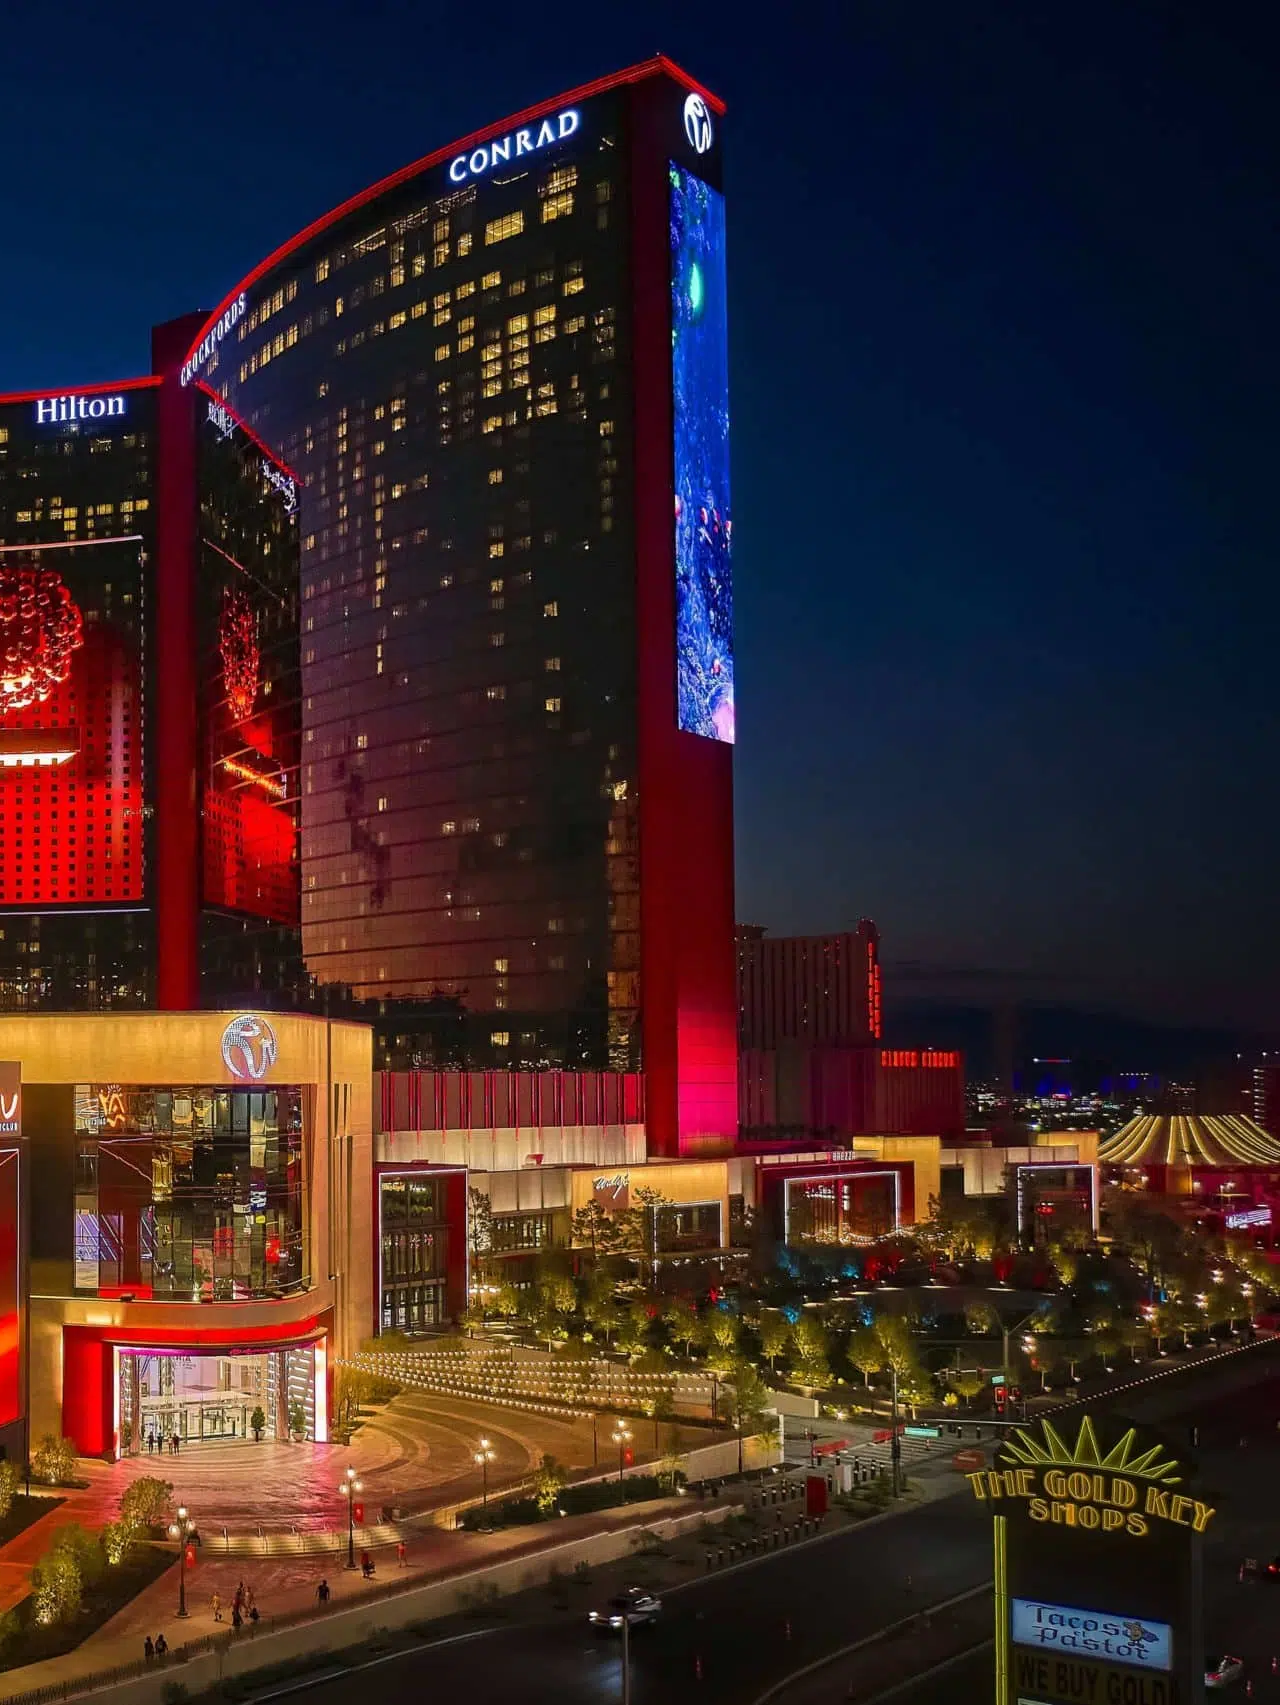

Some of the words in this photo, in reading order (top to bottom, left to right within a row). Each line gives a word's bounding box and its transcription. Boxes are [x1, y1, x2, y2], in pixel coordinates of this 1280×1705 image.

[449, 110, 581, 182] CONRAD
[180, 291, 247, 388] CROCKFORDS
[36, 395, 125, 423] Hilton
[965, 1468, 1037, 1500] THE
[1043, 1470, 1138, 1509] GOLD
[1144, 1486, 1217, 1533] KEY
[1028, 1497, 1149, 1537] SHOPS
[1025, 1603, 1122, 1637] Tacos
[1032, 1625, 1152, 1661] Pastor
[1018, 1653, 1049, 1690] WE
[1055, 1662, 1099, 1701] BUY
[1107, 1671, 1166, 1705] GOLD
